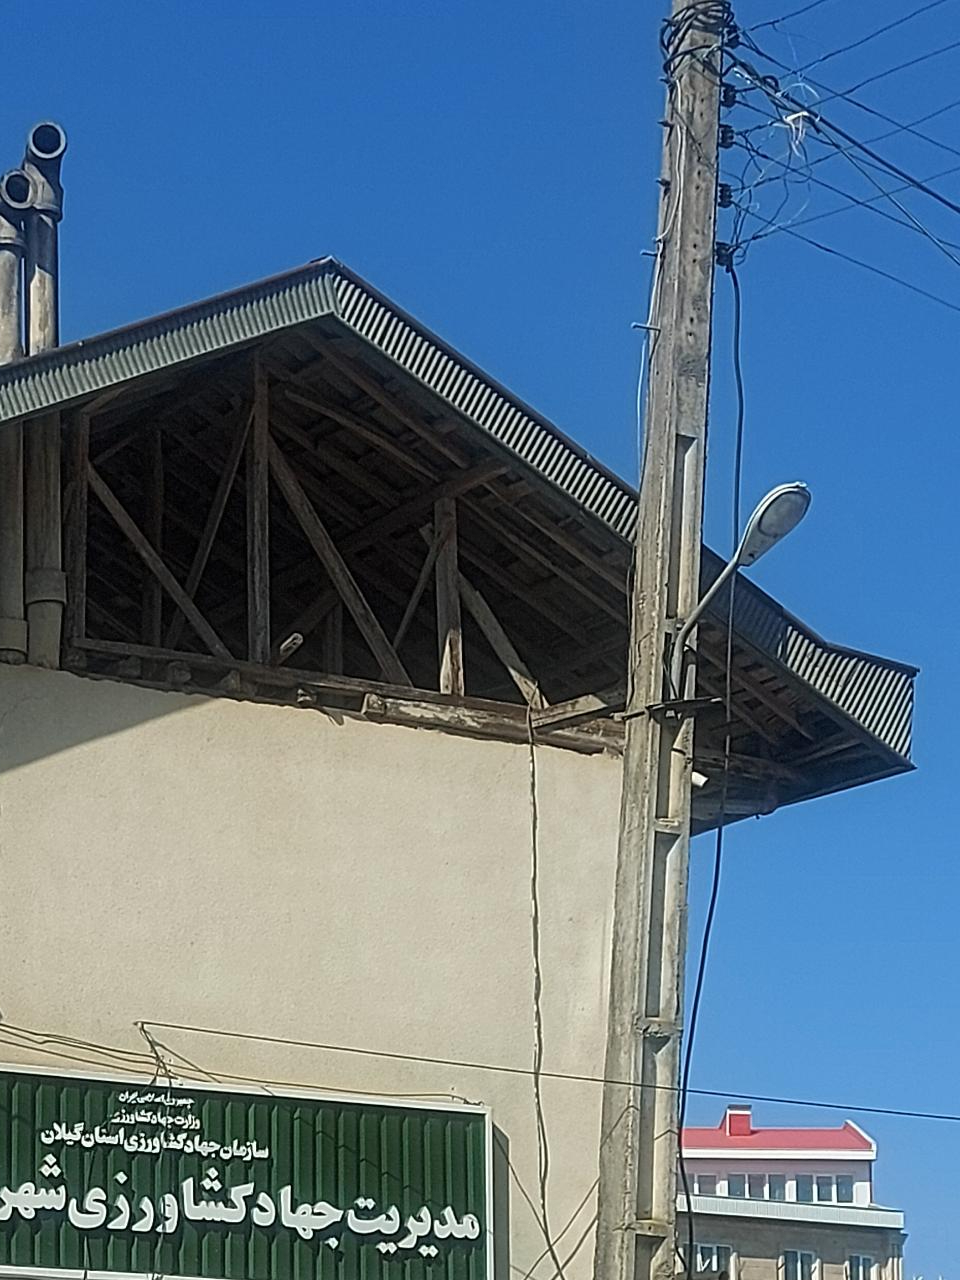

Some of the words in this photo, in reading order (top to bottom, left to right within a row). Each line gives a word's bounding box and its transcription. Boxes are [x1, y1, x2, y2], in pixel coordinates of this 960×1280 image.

[110, 1108, 154, 1125] کشاورزی
[150, 1111, 174, 1129] جهاد
[174, 1112, 201, 1130] وزارت
[40, 1122, 85, 1146] گیلان
[81, 1127, 125, 1147] استان
[123, 1130, 187, 1153] کشاورزی
[183, 1134, 221, 1157] جهاد
[218, 1139, 269, 1161] سازمان
[67, 1166, 255, 1233] کشاورزی
[252, 1184, 343, 1249] جهاد
[346, 1197, 480, 1258] مدیریت
